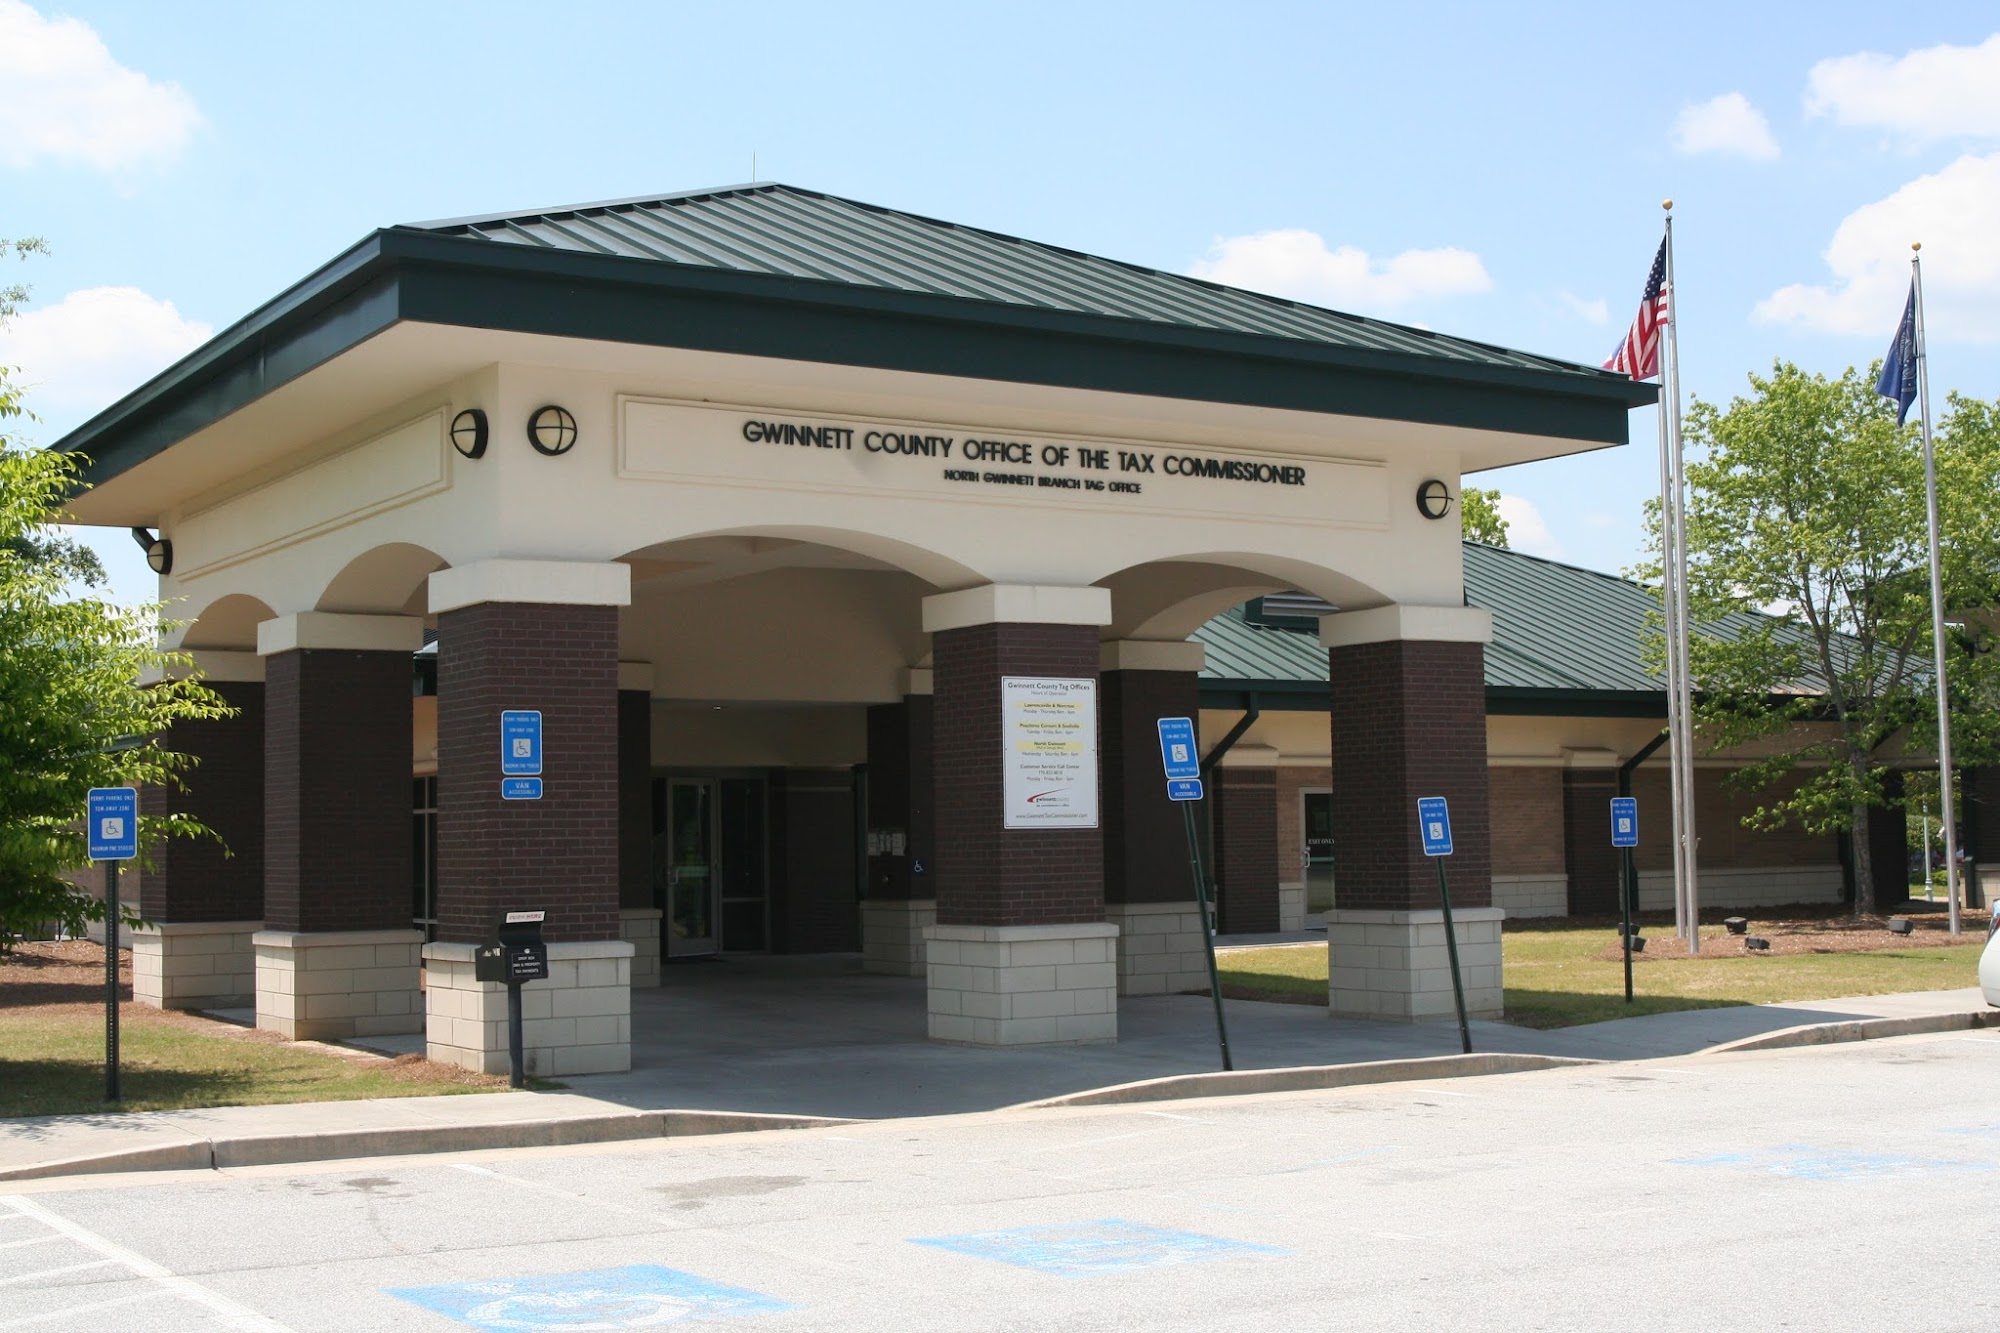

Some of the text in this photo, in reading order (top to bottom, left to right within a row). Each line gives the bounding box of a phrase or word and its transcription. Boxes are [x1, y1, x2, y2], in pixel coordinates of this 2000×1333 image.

[743, 421, 1306, 485] GWINNETT COUNTY OFFICE OF THE TAX COMMISSIONER
[944, 469, 1141, 494] NORTH GWINNETT BRANCH TAG OFFICE
[1008, 682, 1090, 691] Gwinnett County Tag Offices
